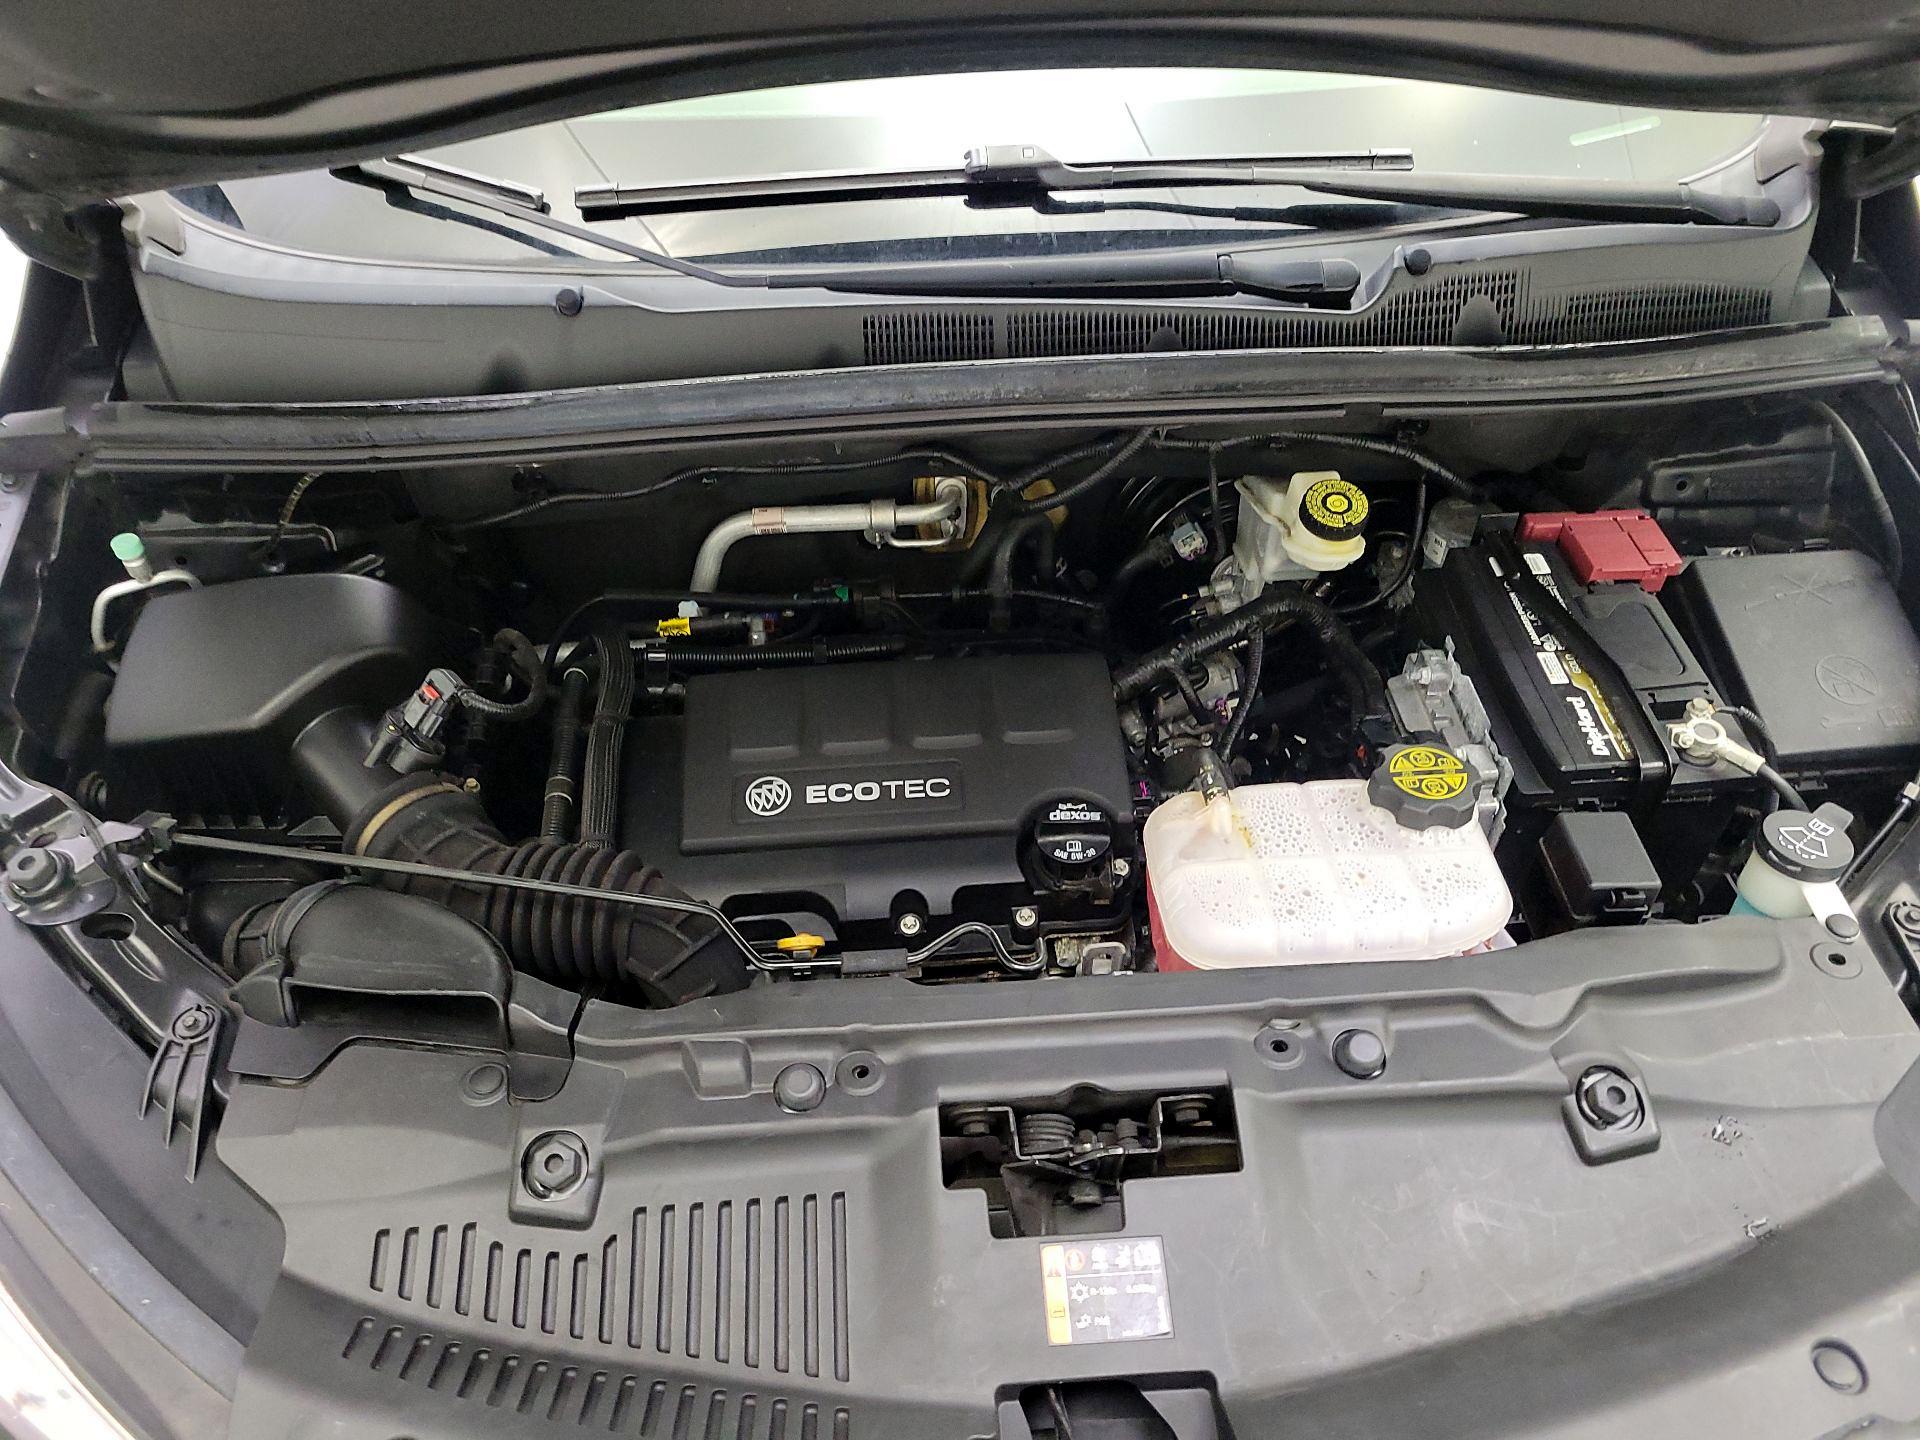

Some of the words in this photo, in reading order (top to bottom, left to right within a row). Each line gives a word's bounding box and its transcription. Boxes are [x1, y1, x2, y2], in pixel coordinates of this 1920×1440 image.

[1566, 696, 1611, 756] DieHard
[806, 778, 951, 804] ECOTEC
[1049, 809, 1102, 821] dexos
[1053, 848, 1069, 860] SAE
